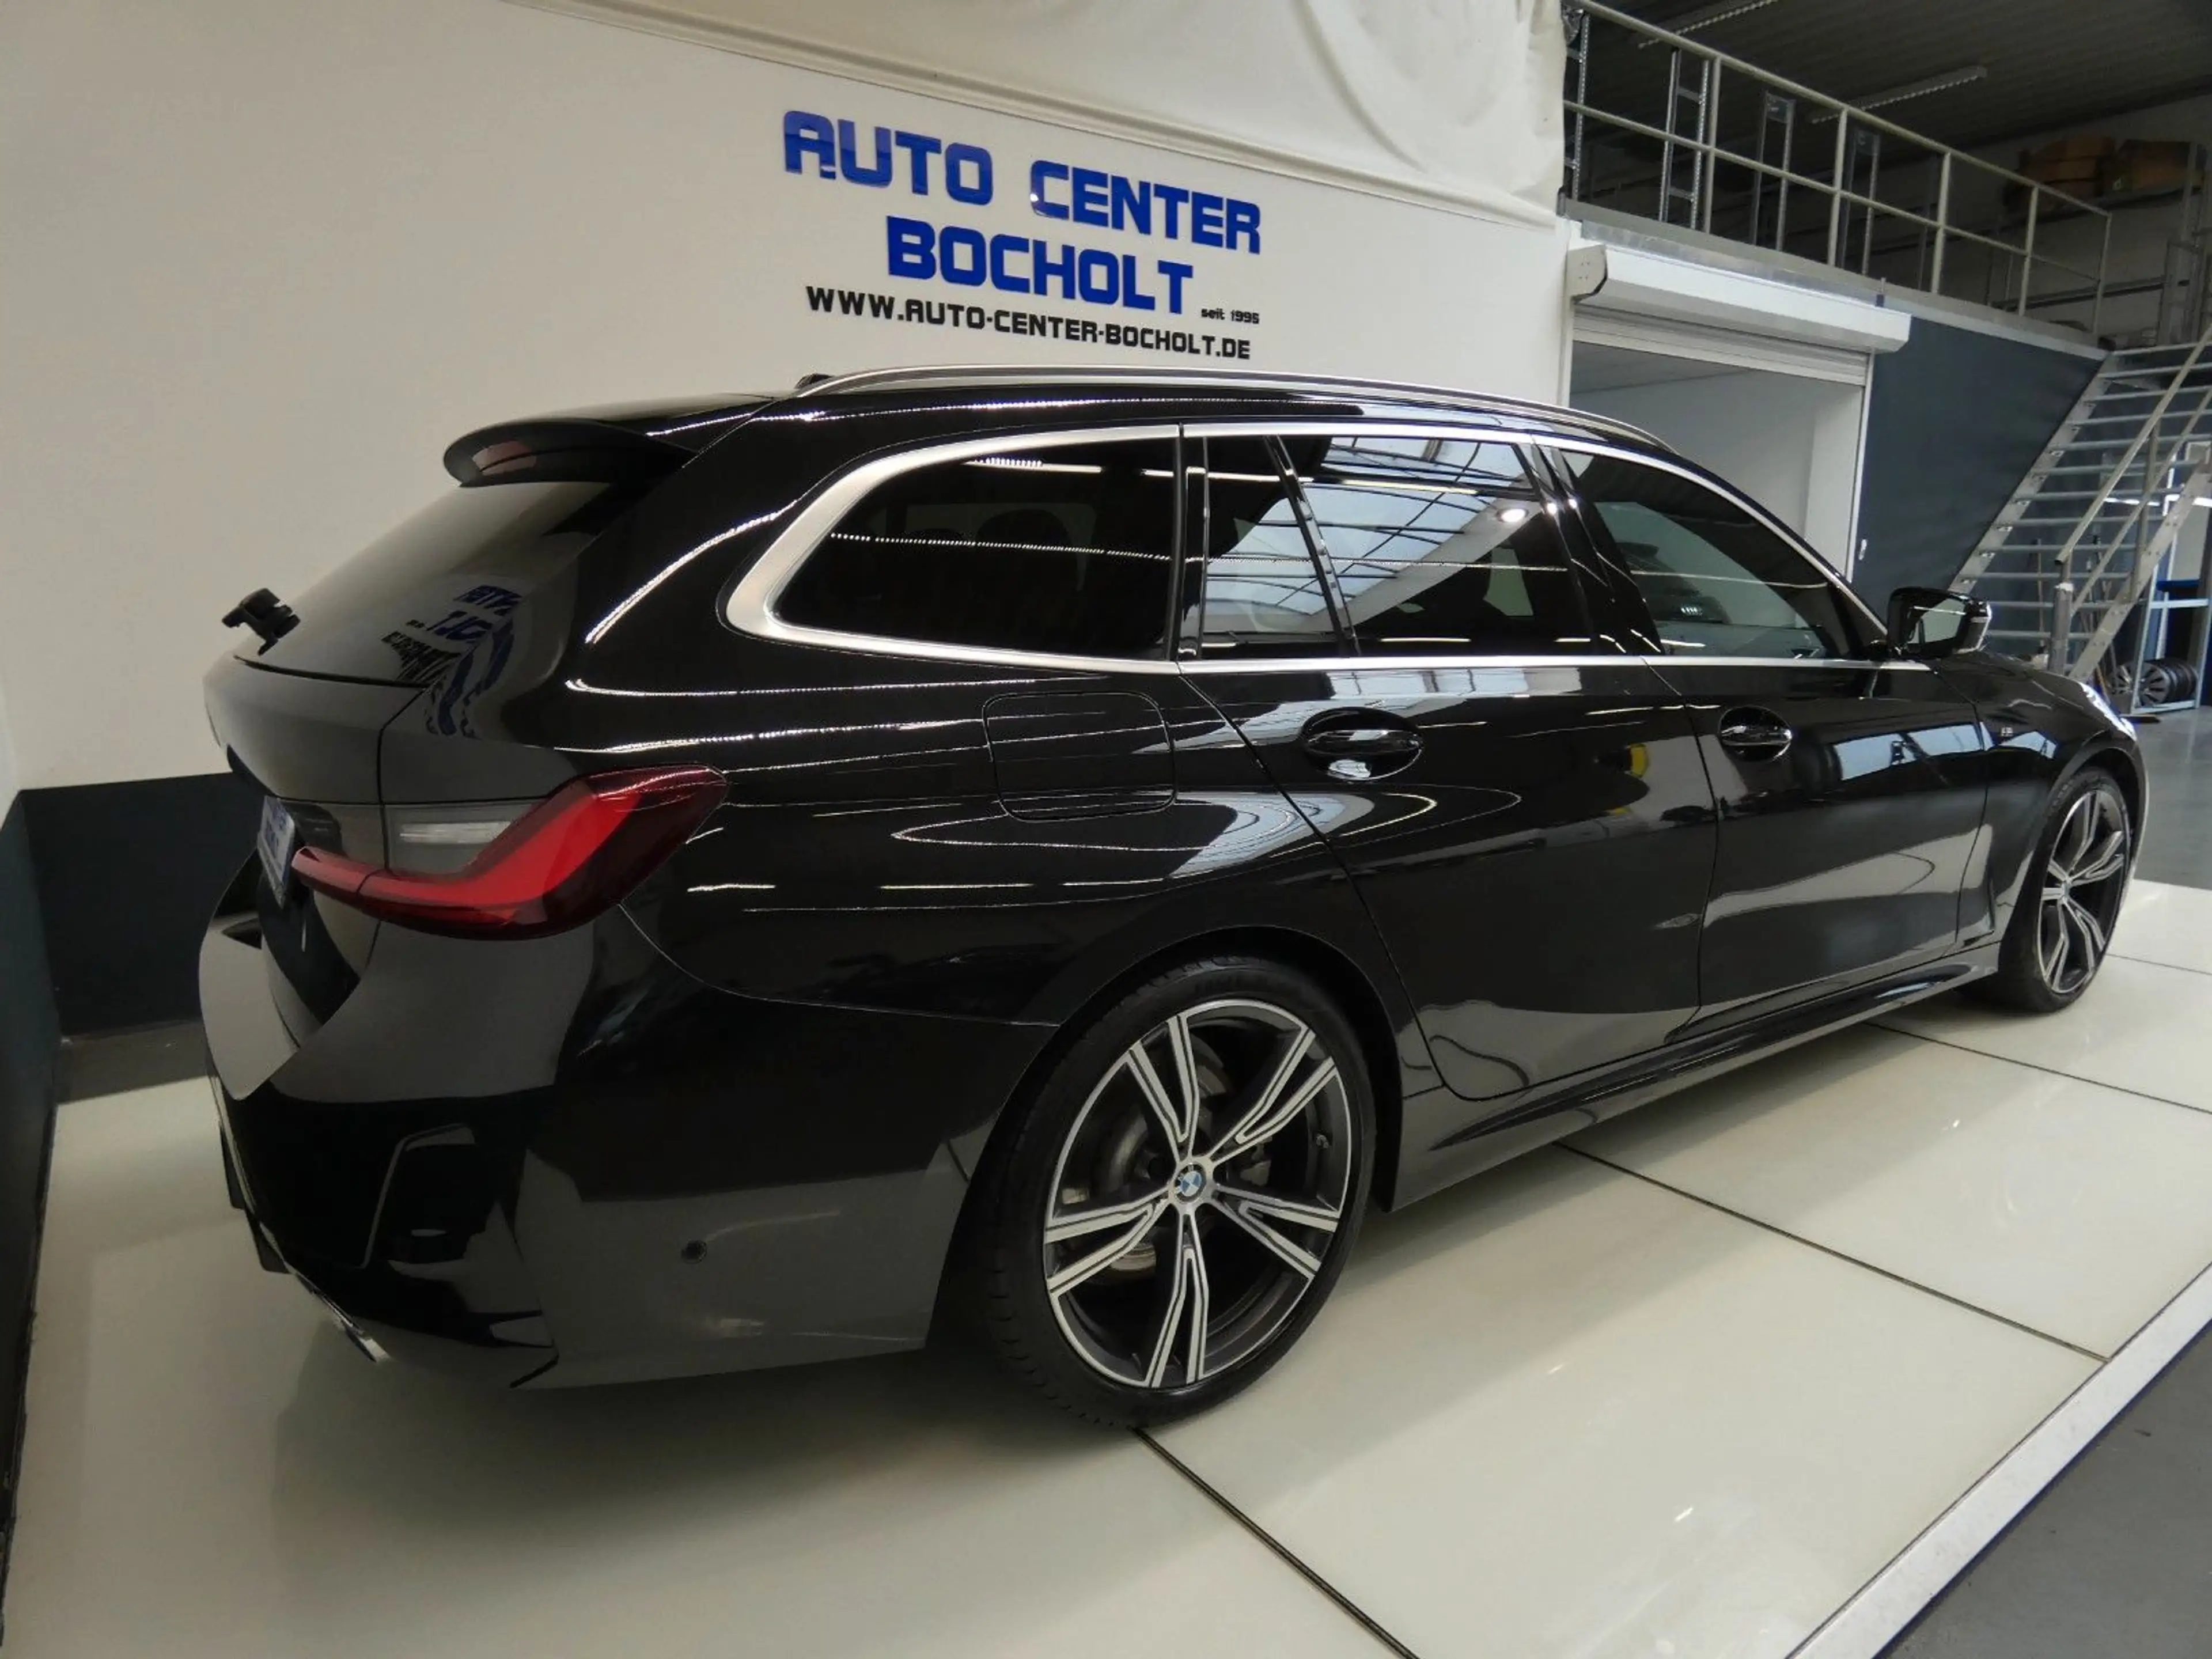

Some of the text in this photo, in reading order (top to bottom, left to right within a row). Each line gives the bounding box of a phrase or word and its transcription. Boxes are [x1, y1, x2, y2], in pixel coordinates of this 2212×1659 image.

[783, 111, 1261, 254] AUTO CENTER
[886, 215, 1194, 315] BOCHOLT
[806, 285, 1251, 360] WWW.AUTO-CENTER-BOCHOLT.DE
[1201, 308, 1260, 325] seit 1995
